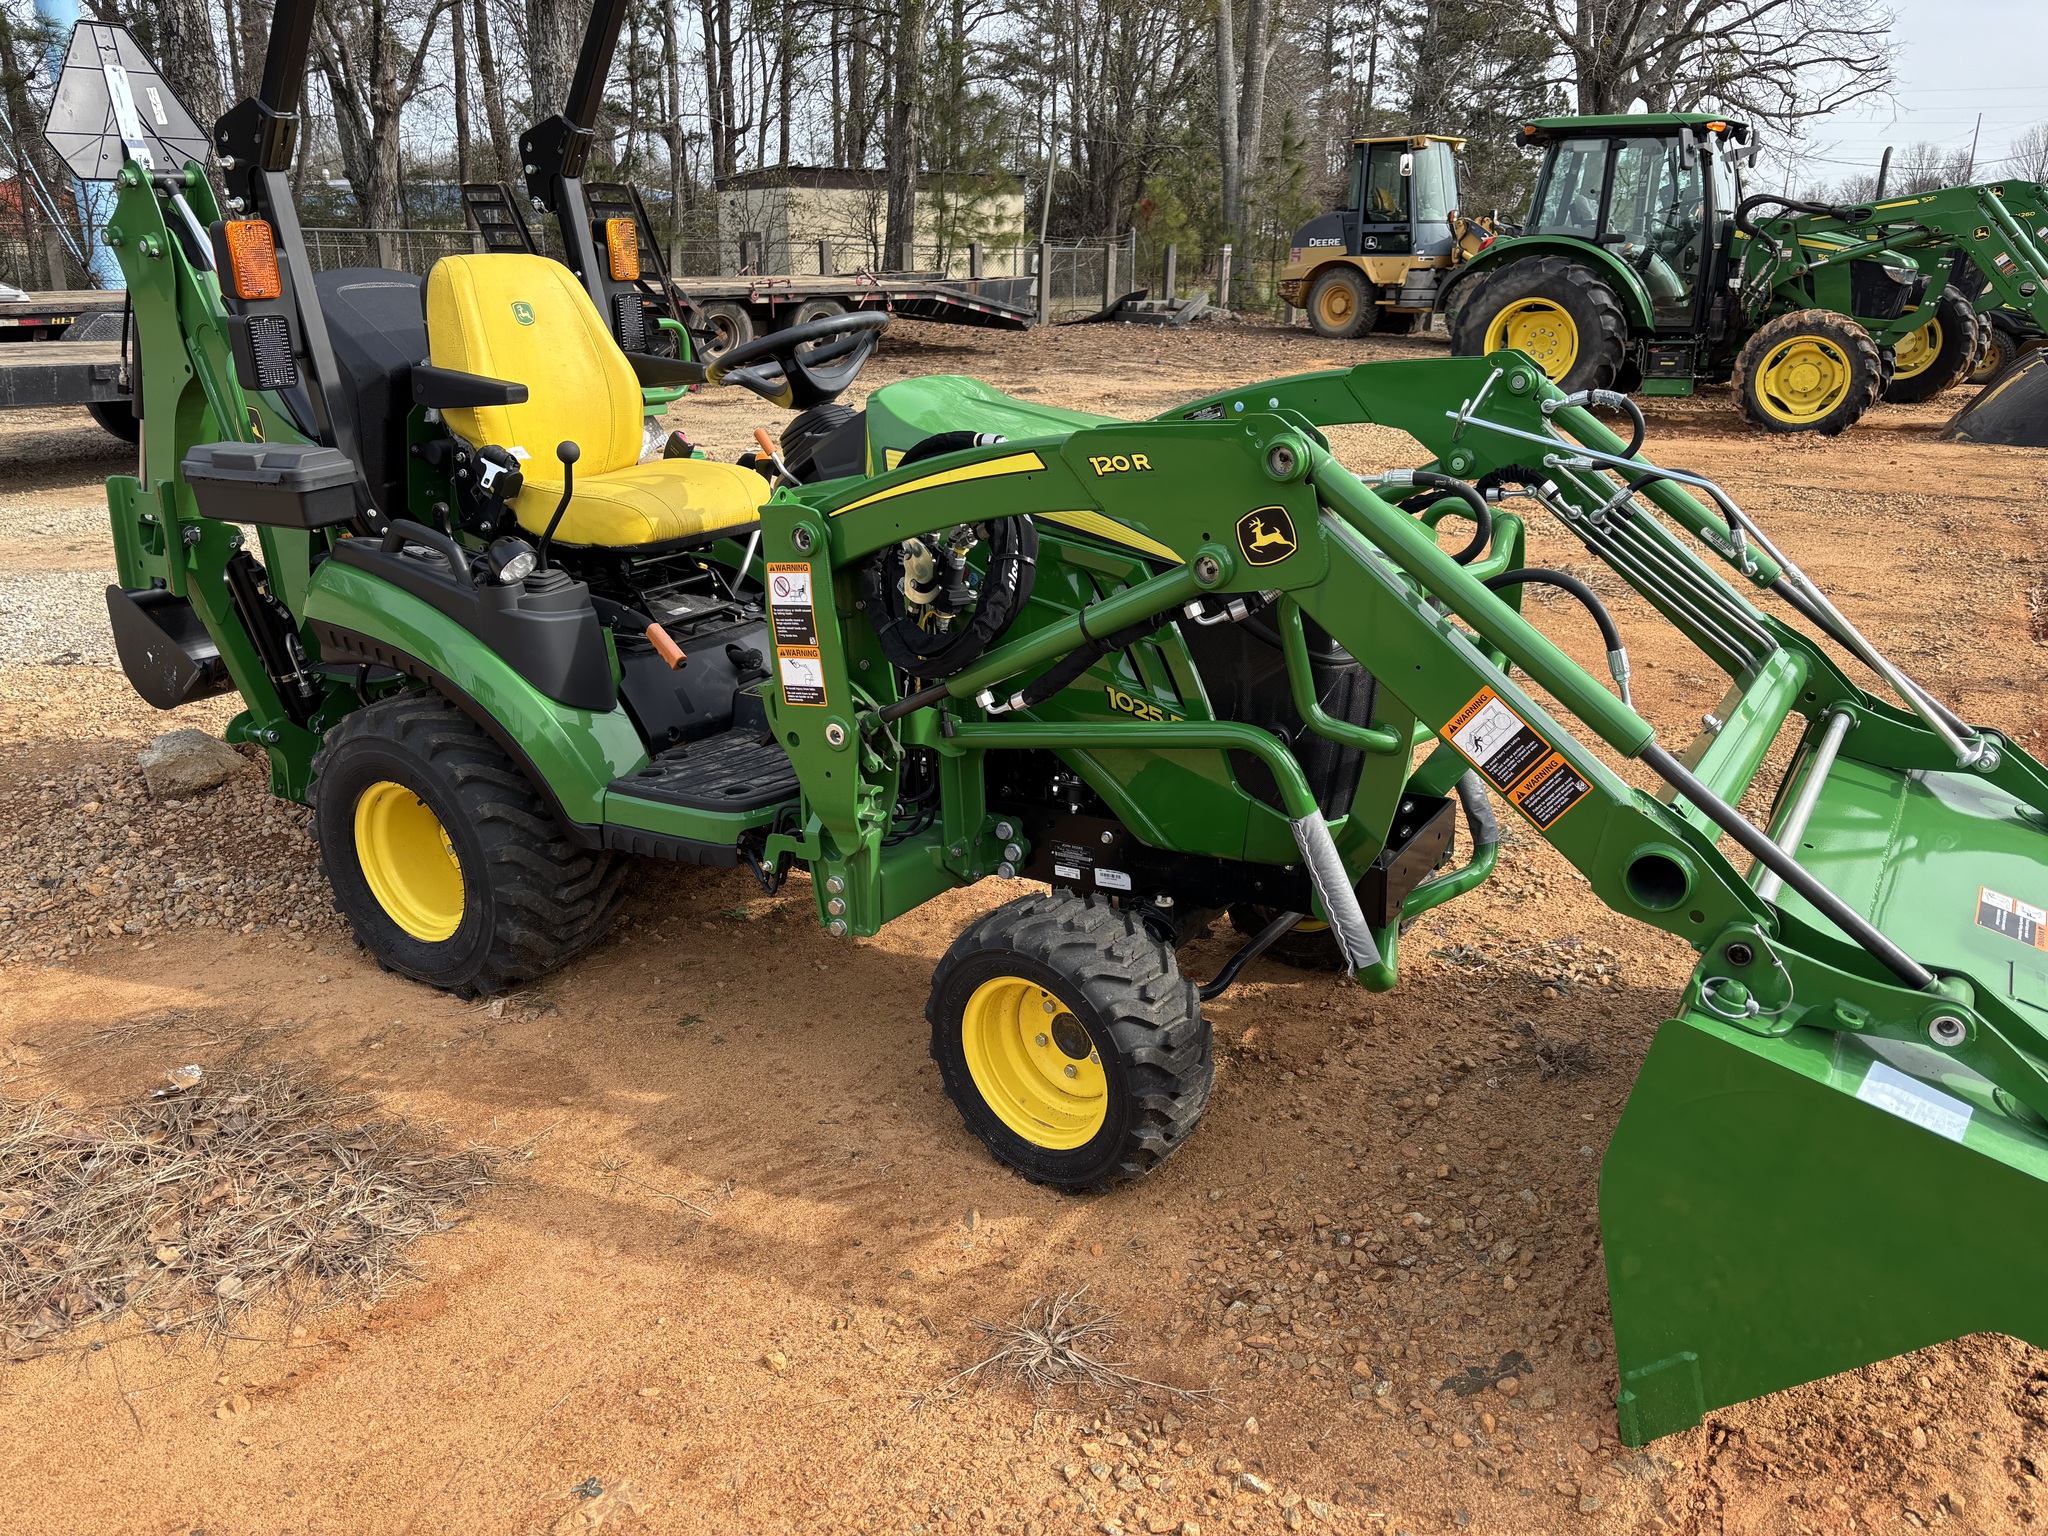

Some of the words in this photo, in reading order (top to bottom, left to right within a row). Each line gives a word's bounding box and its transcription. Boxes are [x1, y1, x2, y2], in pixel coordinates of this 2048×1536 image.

[1309, 238, 1340, 247] DEERE
[786, 649, 818, 657] WARNING
[1455, 694, 1488, 726] WARNING
[1524, 760, 1558, 790] WARNING
